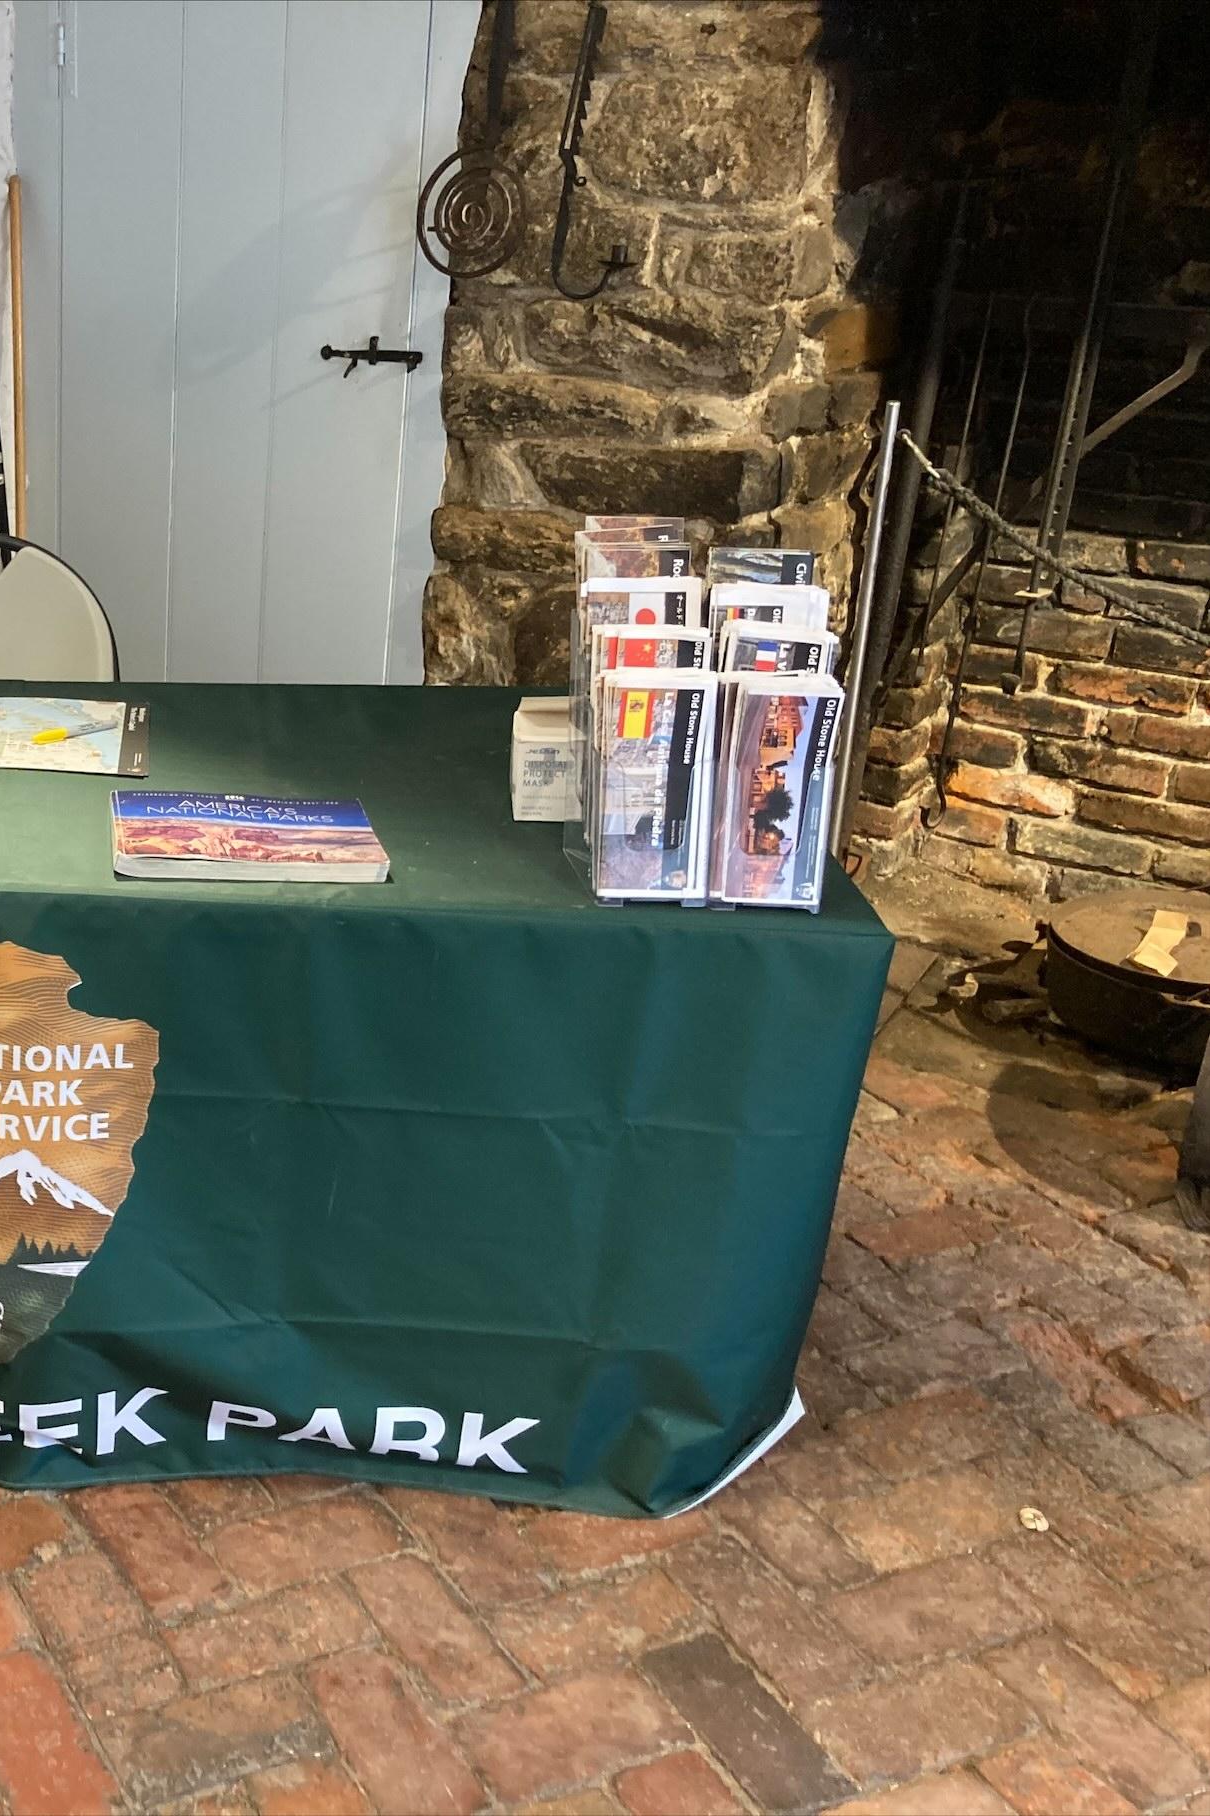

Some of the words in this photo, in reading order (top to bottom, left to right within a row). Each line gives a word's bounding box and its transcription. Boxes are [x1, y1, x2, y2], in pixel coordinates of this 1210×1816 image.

[808, 646, 819, 666] Old
[690, 693, 701, 710] Old
[824, 699, 837, 717] Old
[686, 710, 699, 736] Stone
[818, 719, 832, 747] Stone
[683, 737, 695, 765] House
[812, 750, 826, 781] House
[146, 806, 263, 820] NATIONAL
[267, 813, 334, 823] PARKS
[178, 800, 297, 815] AMERICA'S
[206, 1400, 541, 1474] PARK
